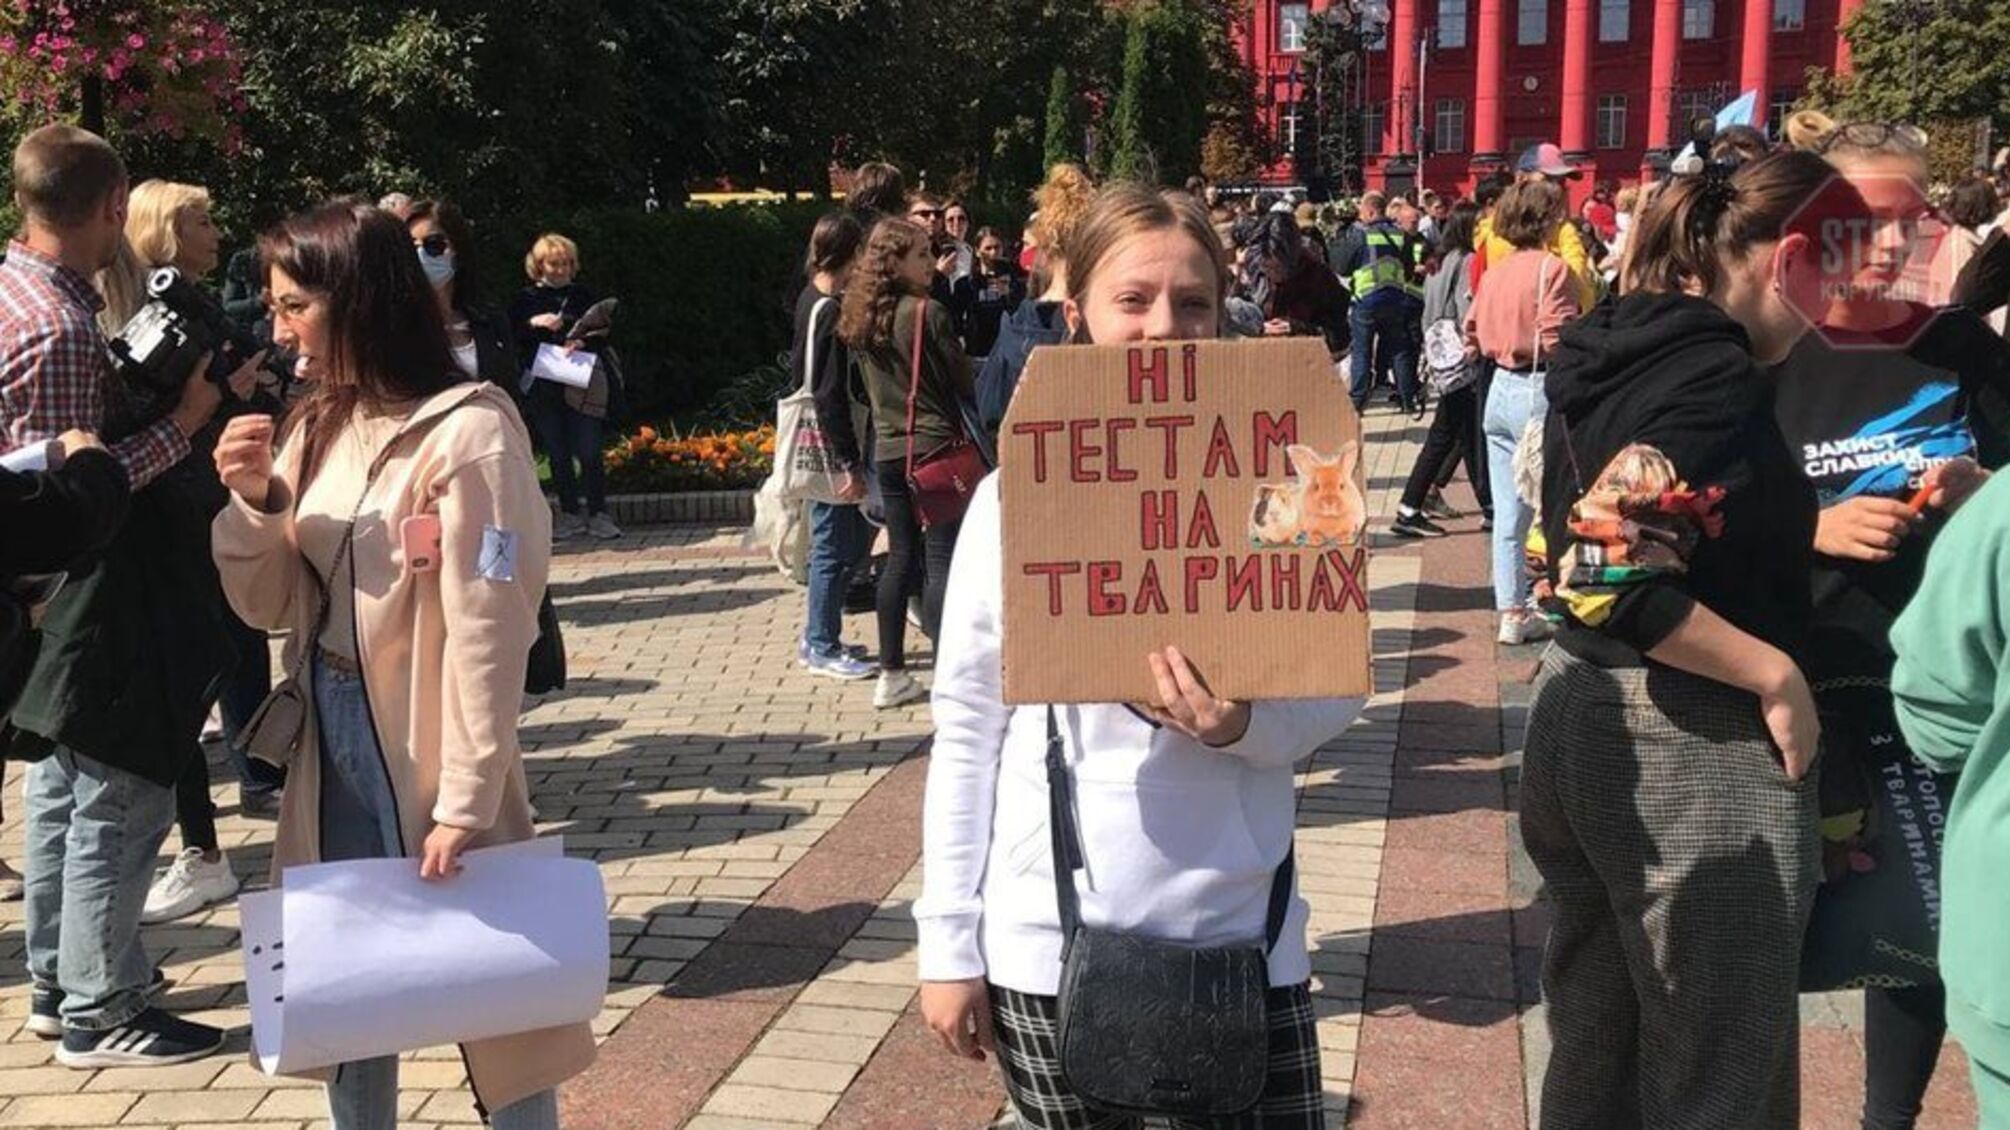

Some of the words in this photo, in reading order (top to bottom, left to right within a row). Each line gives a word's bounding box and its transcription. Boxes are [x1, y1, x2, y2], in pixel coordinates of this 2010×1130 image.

[1013, 410, 1299, 483] ТЕСТАМ
[1803, 432, 1898, 460] ЗАХИСТ
[1804, 445, 1923, 477] СЛАБКИХ
[1141, 489, 1221, 550] НА
[1023, 547, 1369, 616] ТВАРИНАХ
